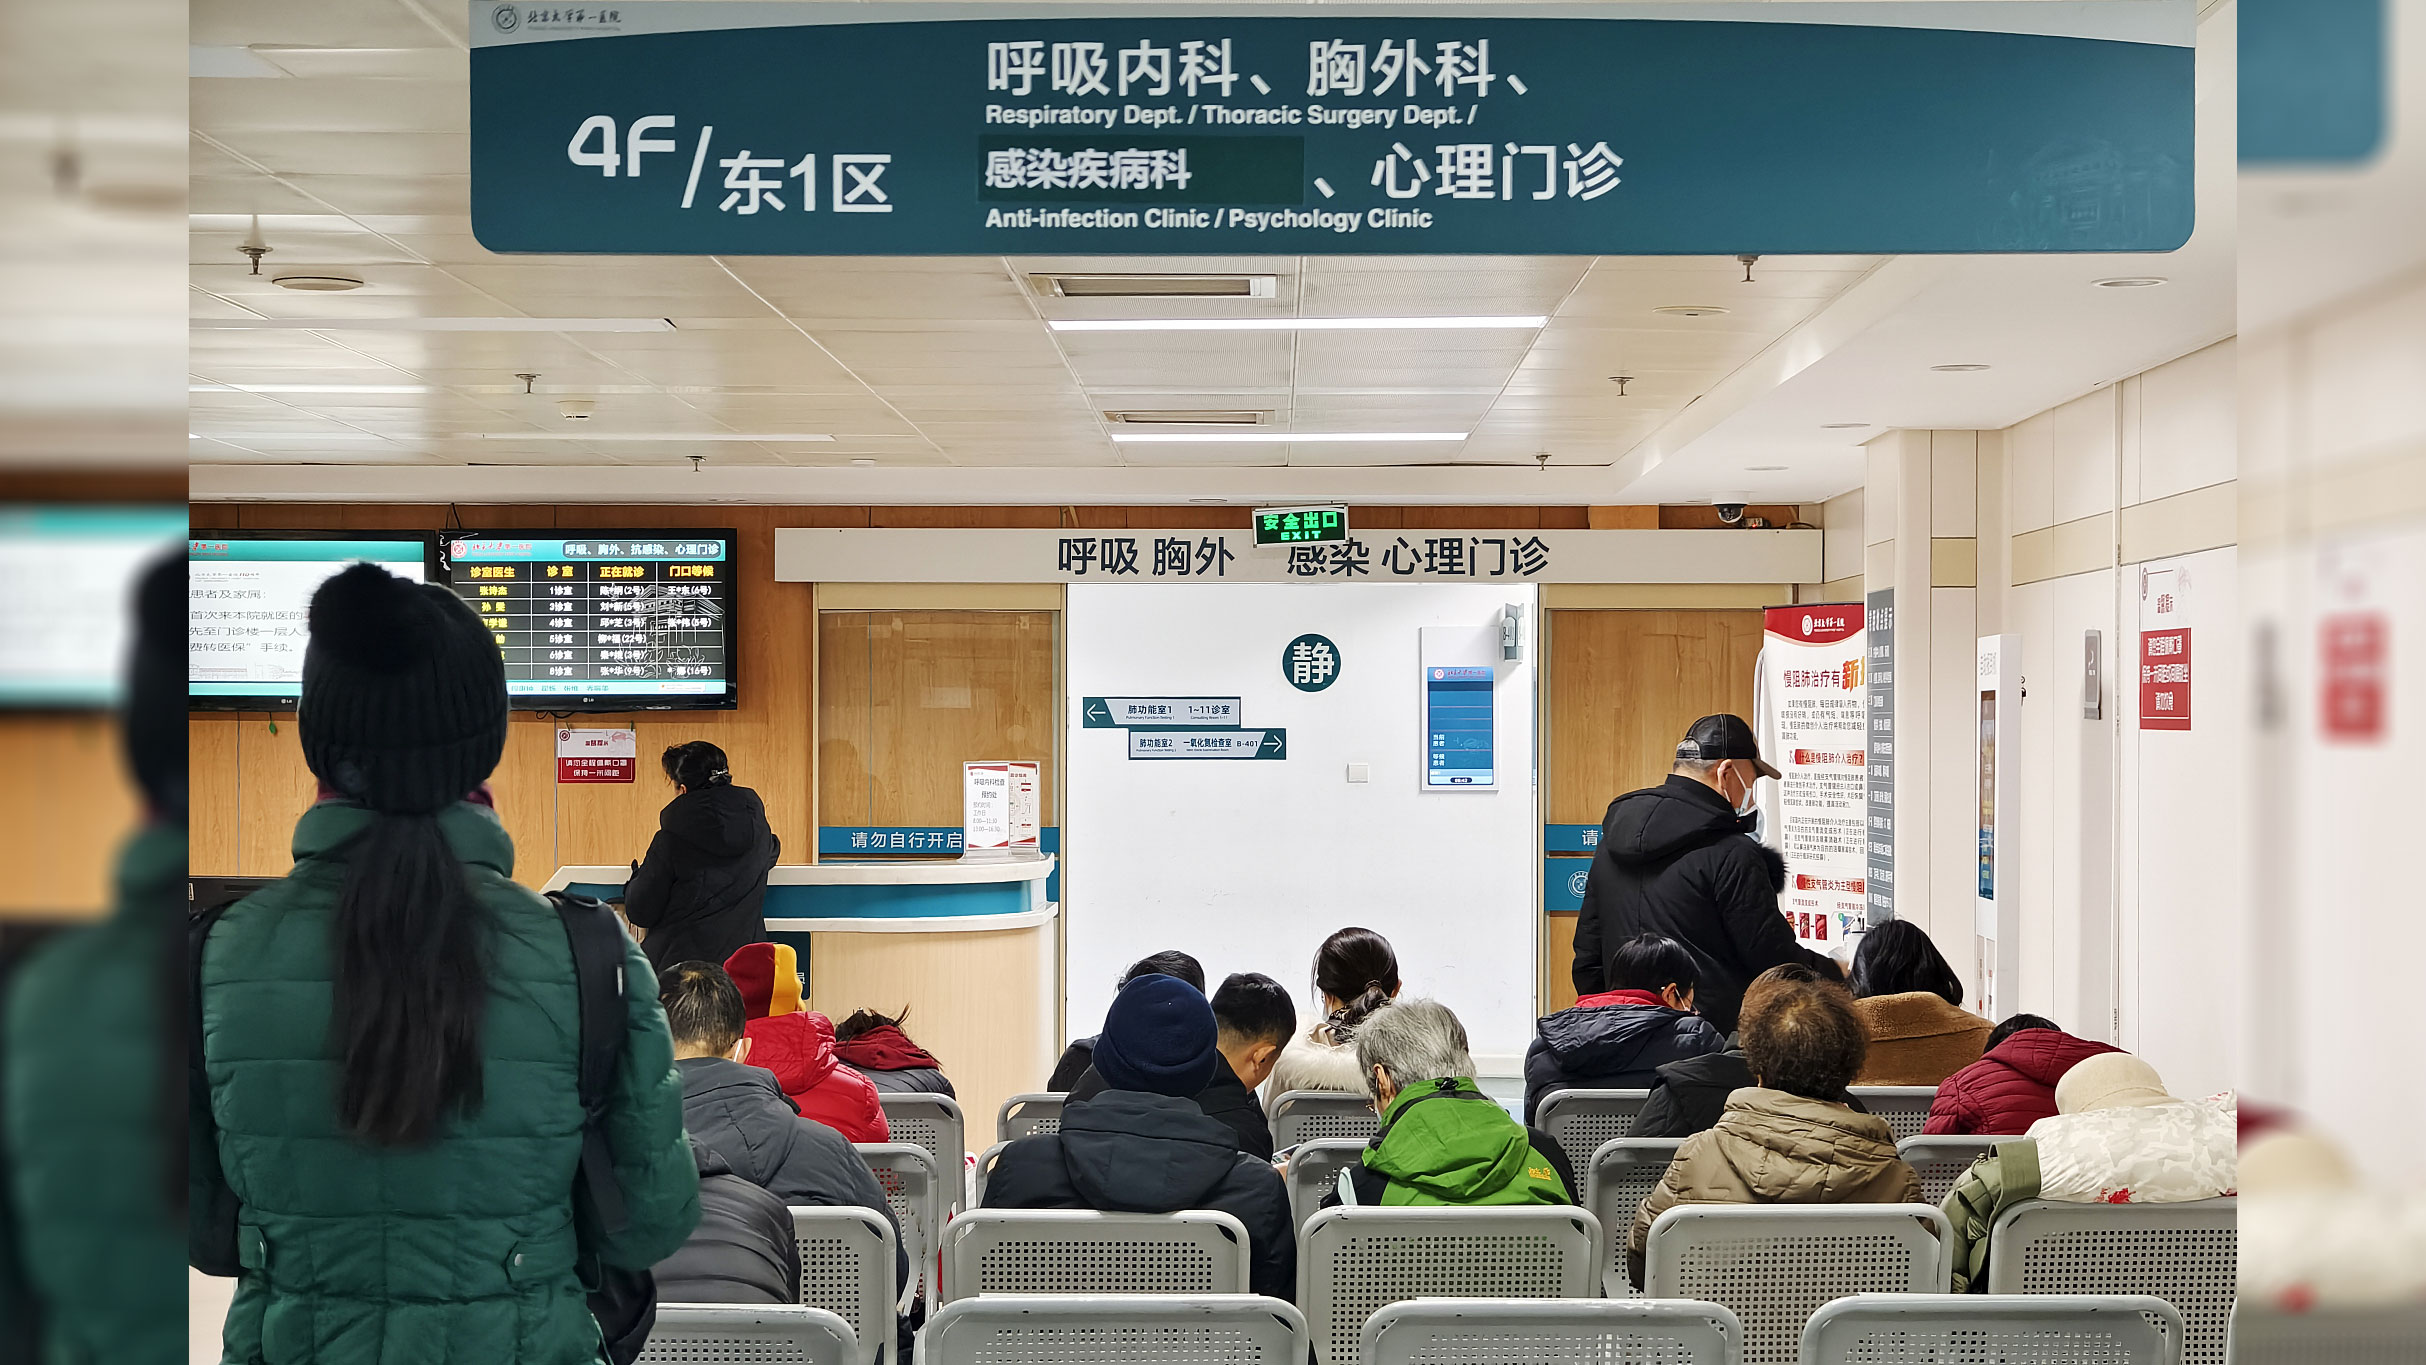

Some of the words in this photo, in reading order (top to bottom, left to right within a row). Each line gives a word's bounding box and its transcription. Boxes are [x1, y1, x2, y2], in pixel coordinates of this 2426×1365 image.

[986, 38, 1529, 98] 呼吸内科、胸外科、
[985, 105, 1118, 128] Respiratory
[1123, 105, 1184, 127] Dept.
[1187, 105, 1199, 124] /
[1202, 105, 1302, 125] Thoracic
[1307, 105, 1398, 128] Surgery
[1403, 105, 1463, 127] Dept.
[1466, 105, 1478, 124] /
[985, 147, 1193, 191] 感染疾病科
[985, 208, 1139, 230] Anti-infection
[1144, 208, 1210, 230] Clinic
[1212, 208, 1224, 230] /
[1228, 208, 1363, 234] Psychology
[1367, 208, 1434, 230] Clinic
[1262, 510, 1339, 532] 安全出口
[1280, 530, 1322, 542] EXIT
[1057, 537, 1140, 577] 呼吸
[1152, 537, 1235, 577] 胸外
[1287, 538, 1370, 577] 感染
[1381, 537, 1550, 577] 心理门诊
[470, 566, 515, 578] 诊室医生
[599, 566, 645, 578] 正在就诊
[669, 565, 715, 578] 门口等候
[549, 585, 573, 596] 1诊室
[549, 601, 573, 612] 3诊室
[190, 610, 307, 620] 首次来本院就医的
[548, 617, 573, 628] 4诊室
[189, 626, 308, 637] 先至门诊楼一层人
[549, 633, 573, 644] 5诊室
[549, 649, 573, 660] 6诊室
[1292, 642, 1335, 684] 静
[1127, 704, 1173, 715] 肺功能室1
[1138, 738, 1173, 748] 肺功能室2
[850, 830, 963, 849] 请勿自行开启
